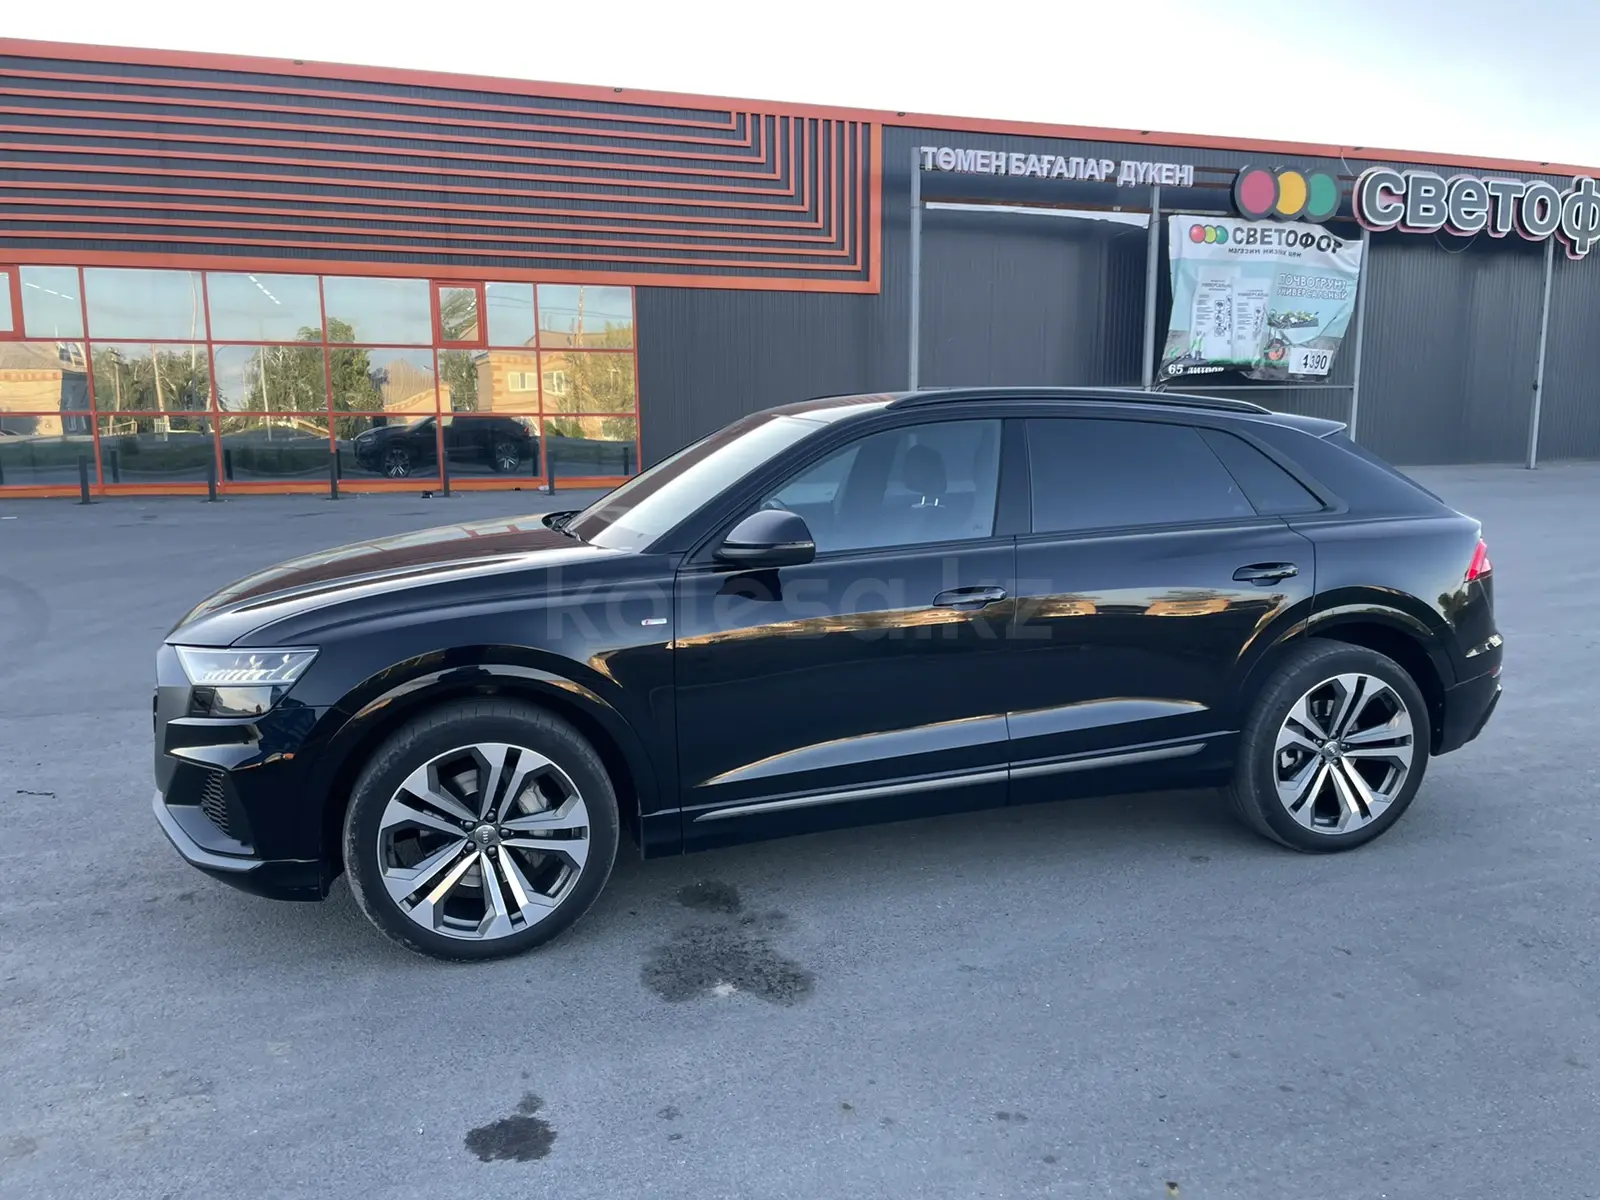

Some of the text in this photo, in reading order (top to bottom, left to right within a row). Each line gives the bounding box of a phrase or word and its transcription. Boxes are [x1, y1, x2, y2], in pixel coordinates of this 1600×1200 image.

[921, 146, 1005, 175] ТӨМЕН
[1008, 152, 1114, 182] БАҒАЛАР
[1168, 364, 1184, 374] 65
